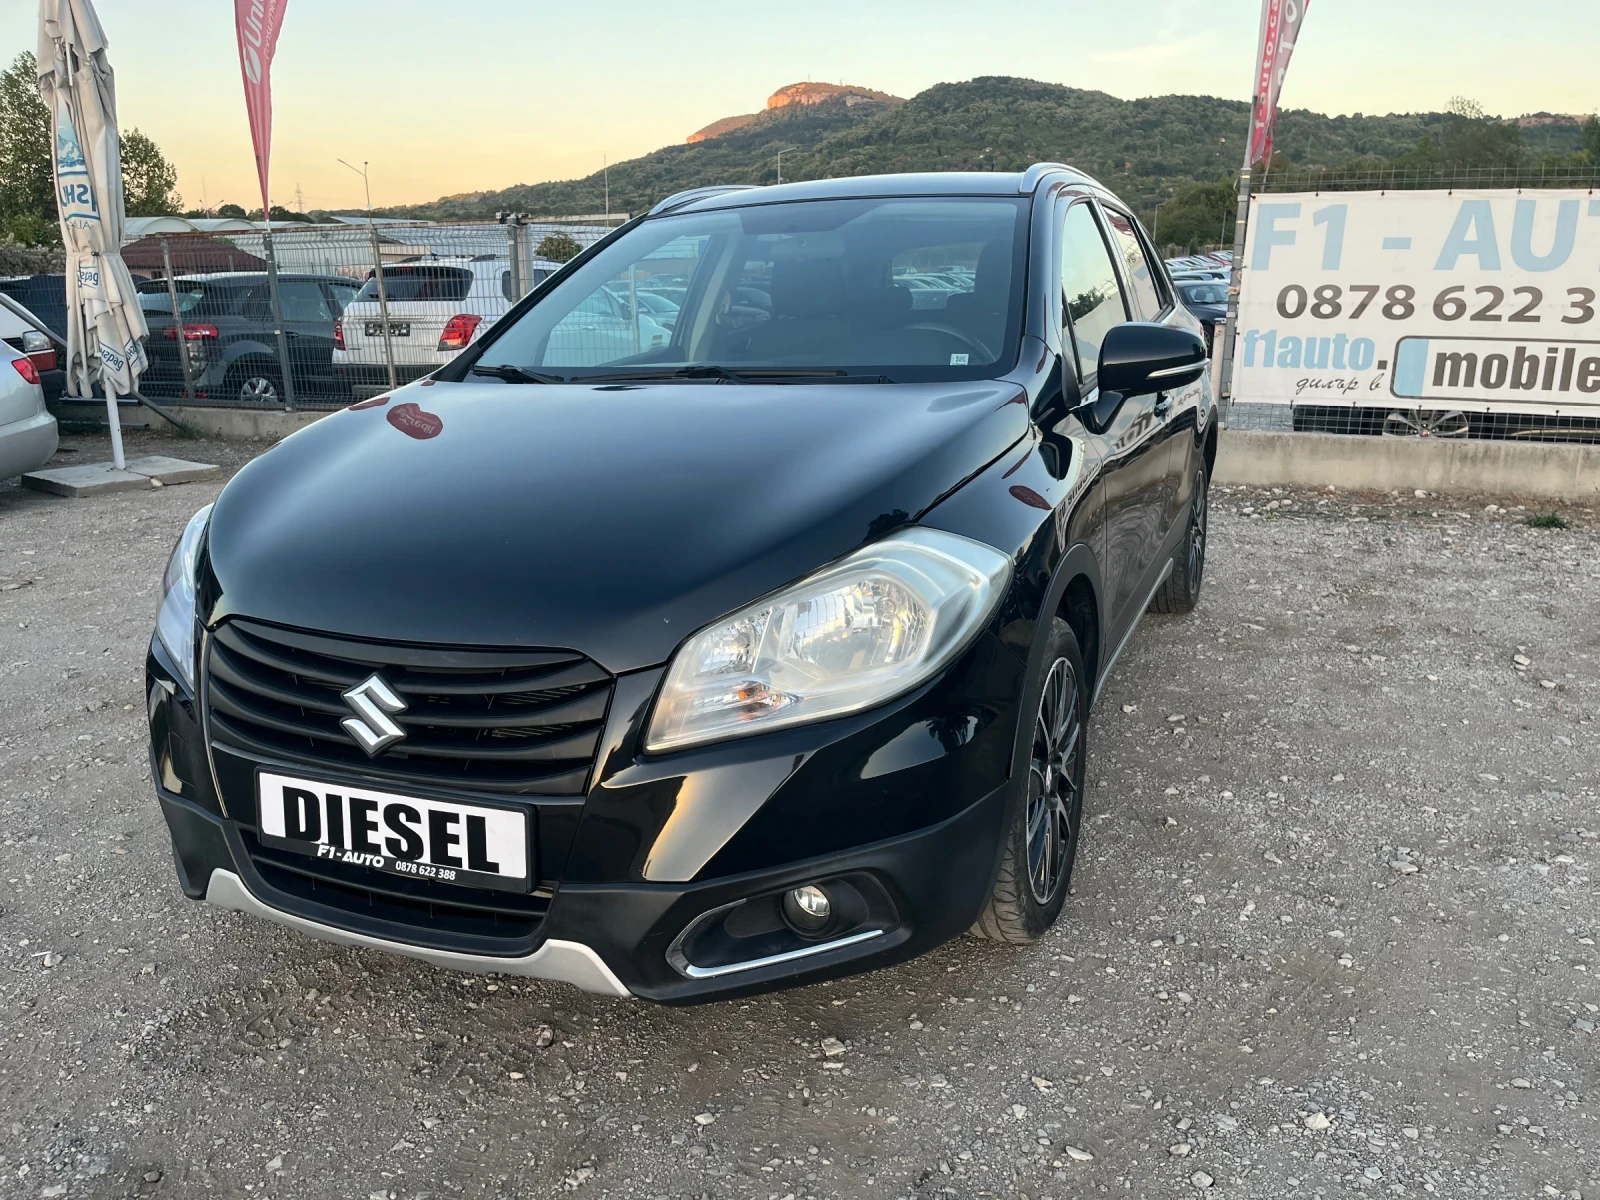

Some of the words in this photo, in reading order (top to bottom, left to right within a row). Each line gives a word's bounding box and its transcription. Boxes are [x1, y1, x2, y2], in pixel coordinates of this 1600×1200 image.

[244, 0, 264, 47] Uni
[264, 0, 277, 60] consume
[1251, 203, 1348, 271] F1
[1433, 199, 1600, 272] AU
[1276, 284, 1415, 320] 0878
[1432, 285, 1544, 323] 622
[1296, 376, 1360, 395] дилър
[1432, 346, 1600, 393] mobile
[282, 785, 500, 874] DIESEL
[317, 844, 385, 868] F1-AUTO
[395, 861, 417, 874] 0878
[419, 865, 436, 877] 622
[438, 869, 456, 880] 388
